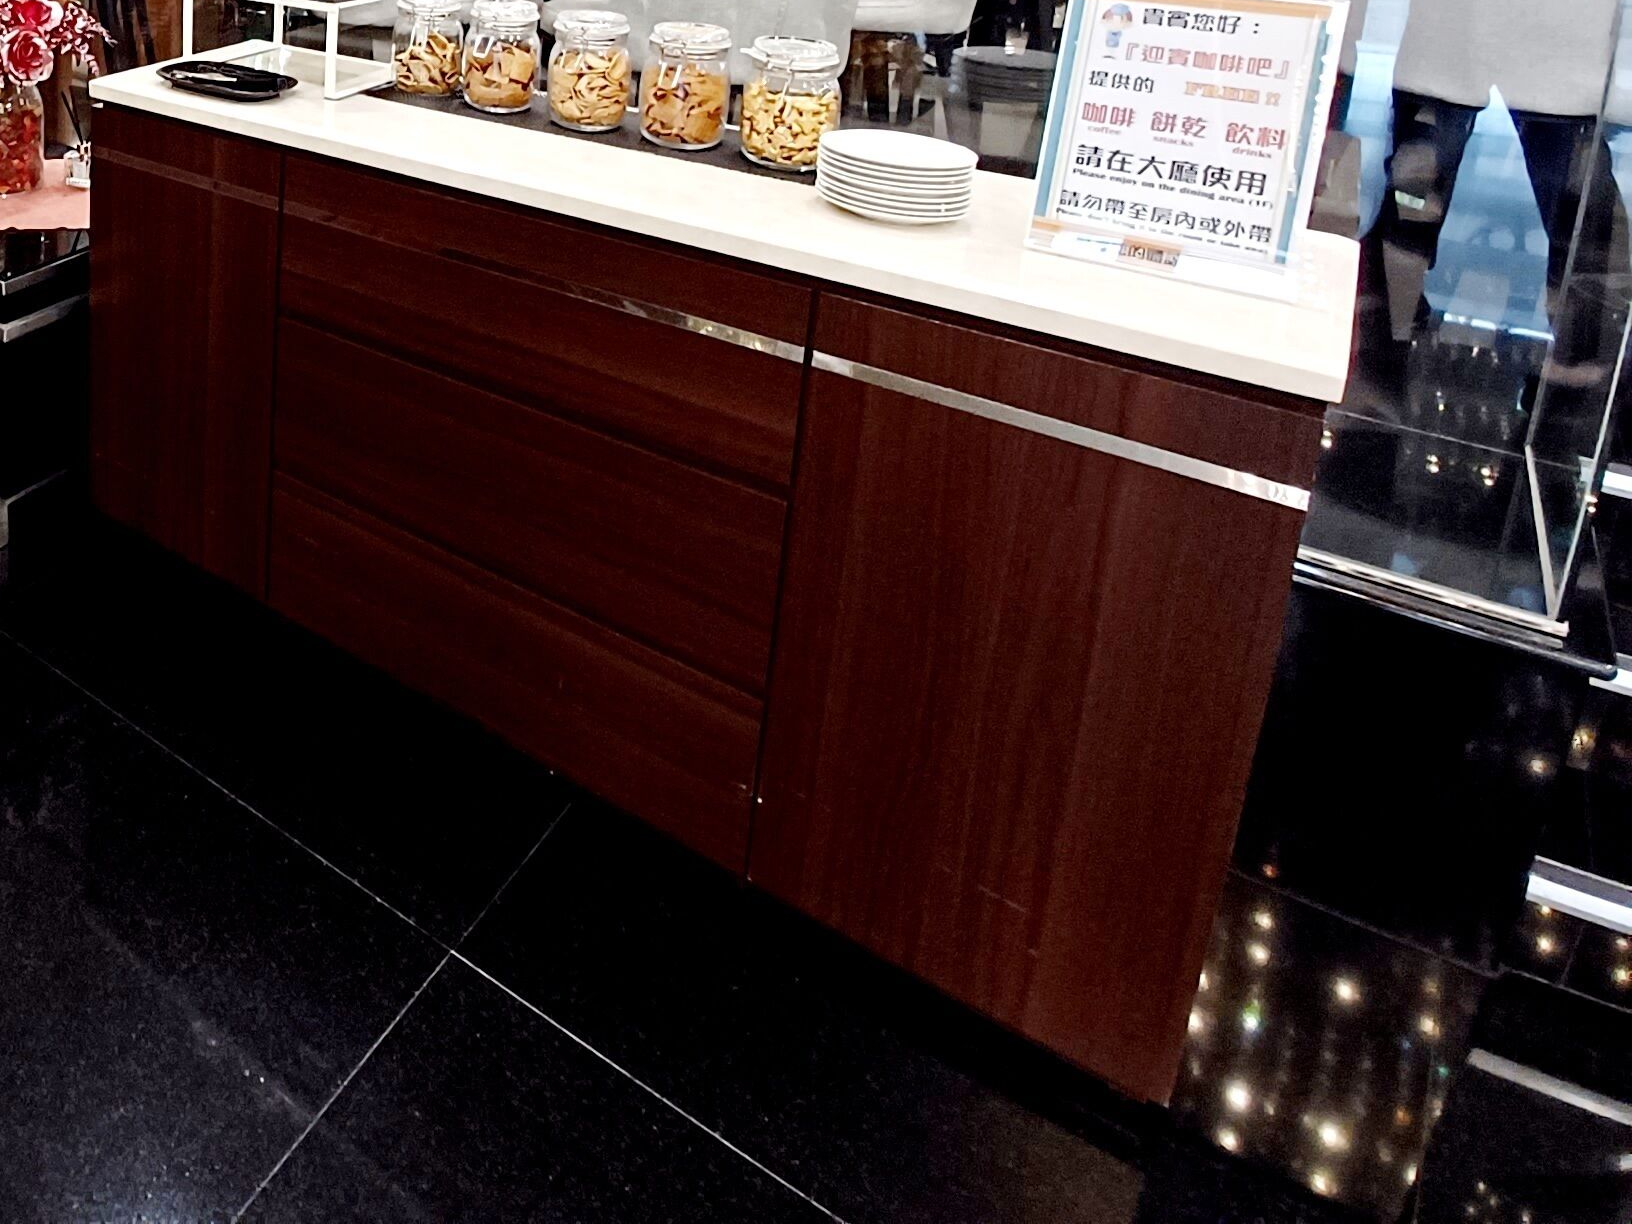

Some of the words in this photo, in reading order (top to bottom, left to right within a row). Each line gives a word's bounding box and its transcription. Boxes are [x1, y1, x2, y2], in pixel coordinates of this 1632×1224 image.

[1088, 70, 1155, 94] 提供的
[1081, 102, 1137, 128] 咖啡
[1150, 111, 1209, 139] 餅乾
[1225, 122, 1287, 150] 飲料
[1073, 167, 1107, 179] Please
[1109, 175, 1137, 185] enjoy
[1158, 183, 1175, 192] the
[1179, 187, 1215, 200] dining
[1074, 143, 1268, 196] 請在大廳使用
[1059, 189, 1273, 244] 請勿帶至房內或外帶
